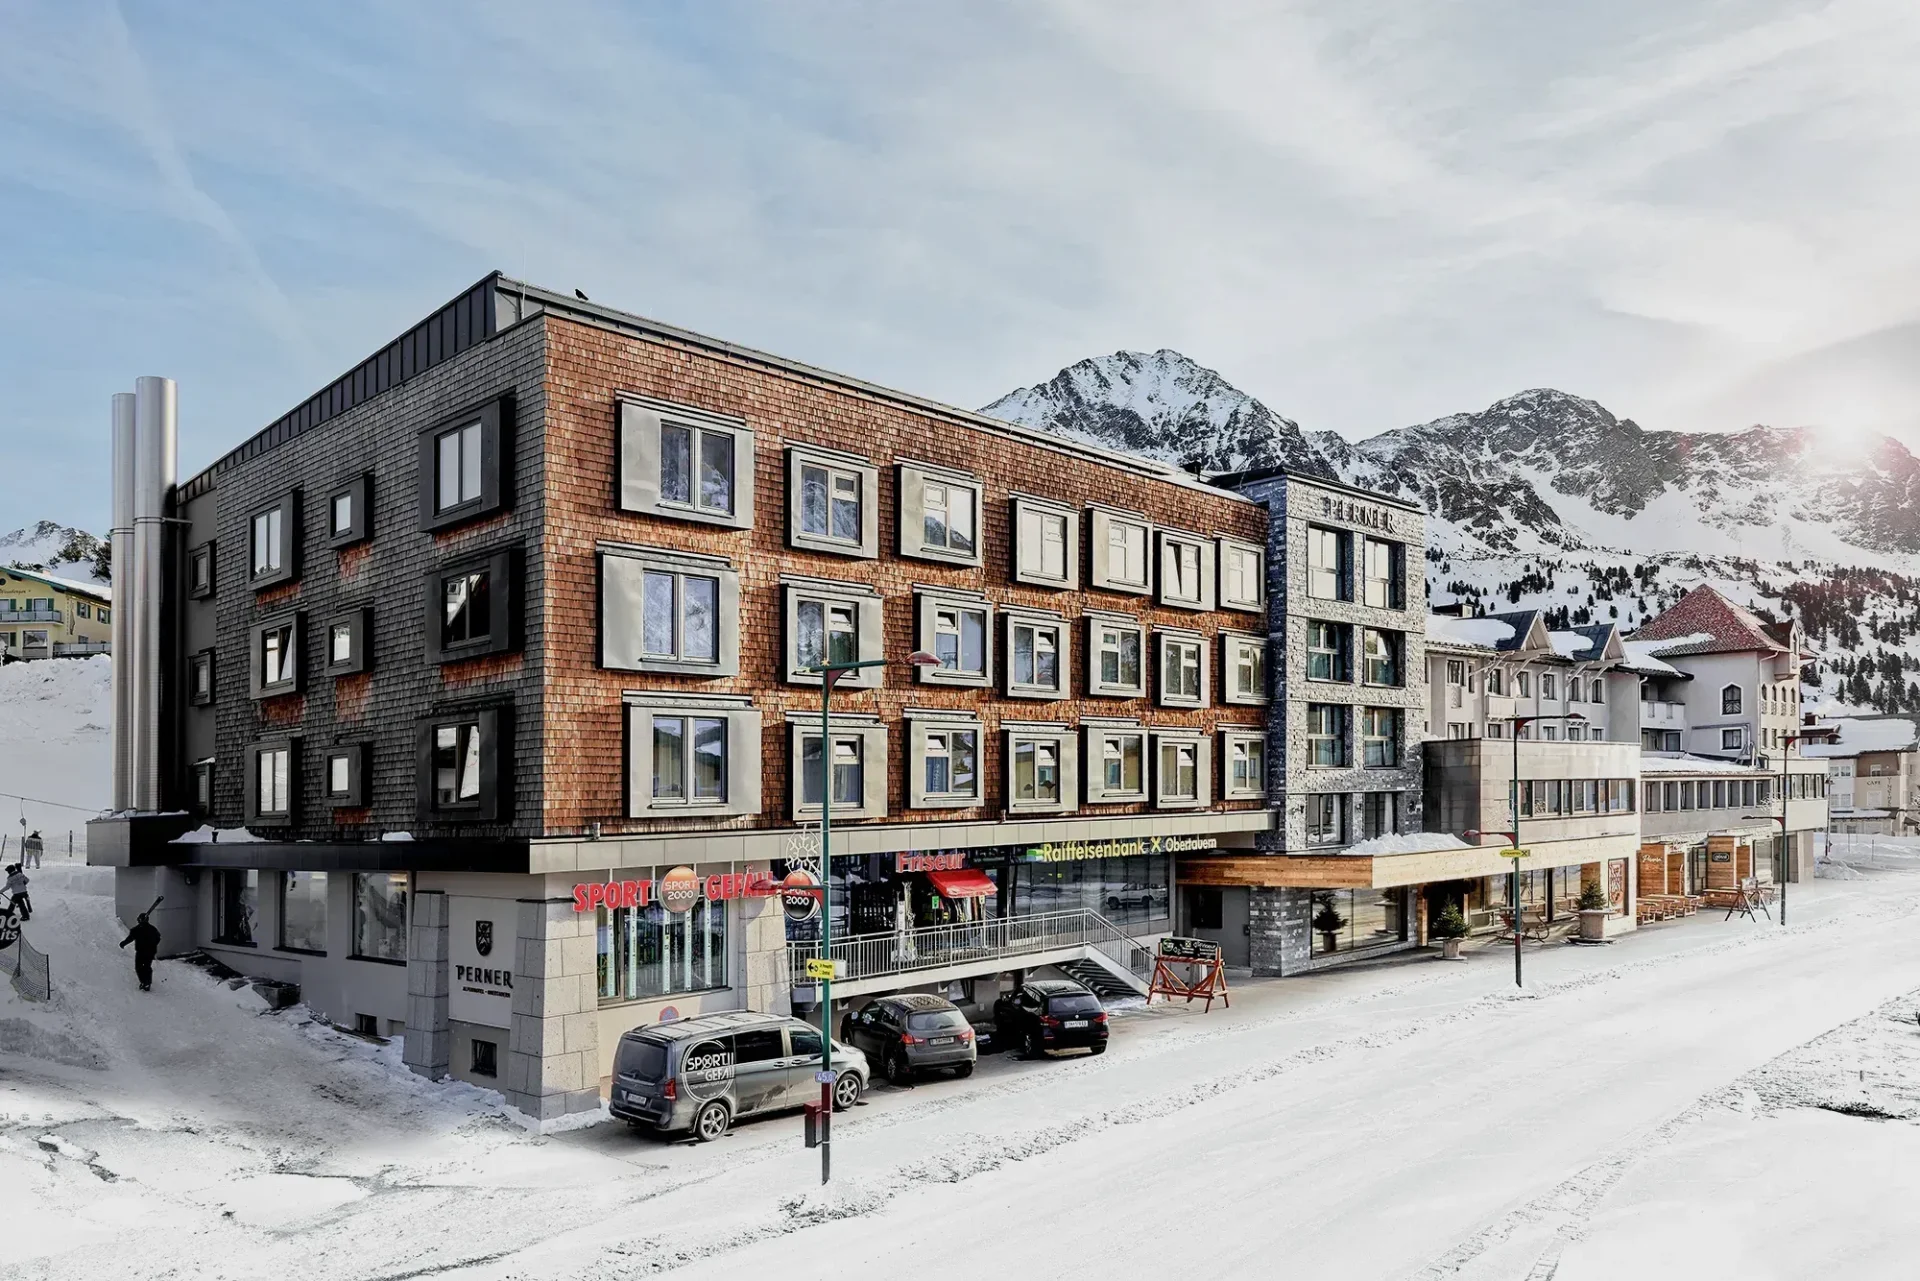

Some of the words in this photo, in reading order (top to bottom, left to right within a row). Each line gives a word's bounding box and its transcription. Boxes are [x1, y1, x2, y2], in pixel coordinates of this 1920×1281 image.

[1327, 498, 1399, 535] PERNER
[1043, 838, 1146, 862] Raiffeisenbank
[1165, 835, 1218, 852] Obertauern
[895, 851, 966, 873] Friseur
[573, 880, 651, 912] SPORT
[665, 880, 696, 890] SPORT
[667, 890, 694, 900] 2000
[786, 896, 809, 906] 2000
[456, 965, 513, 989] PERNER
[687, 1052, 727, 1070] SPORT
